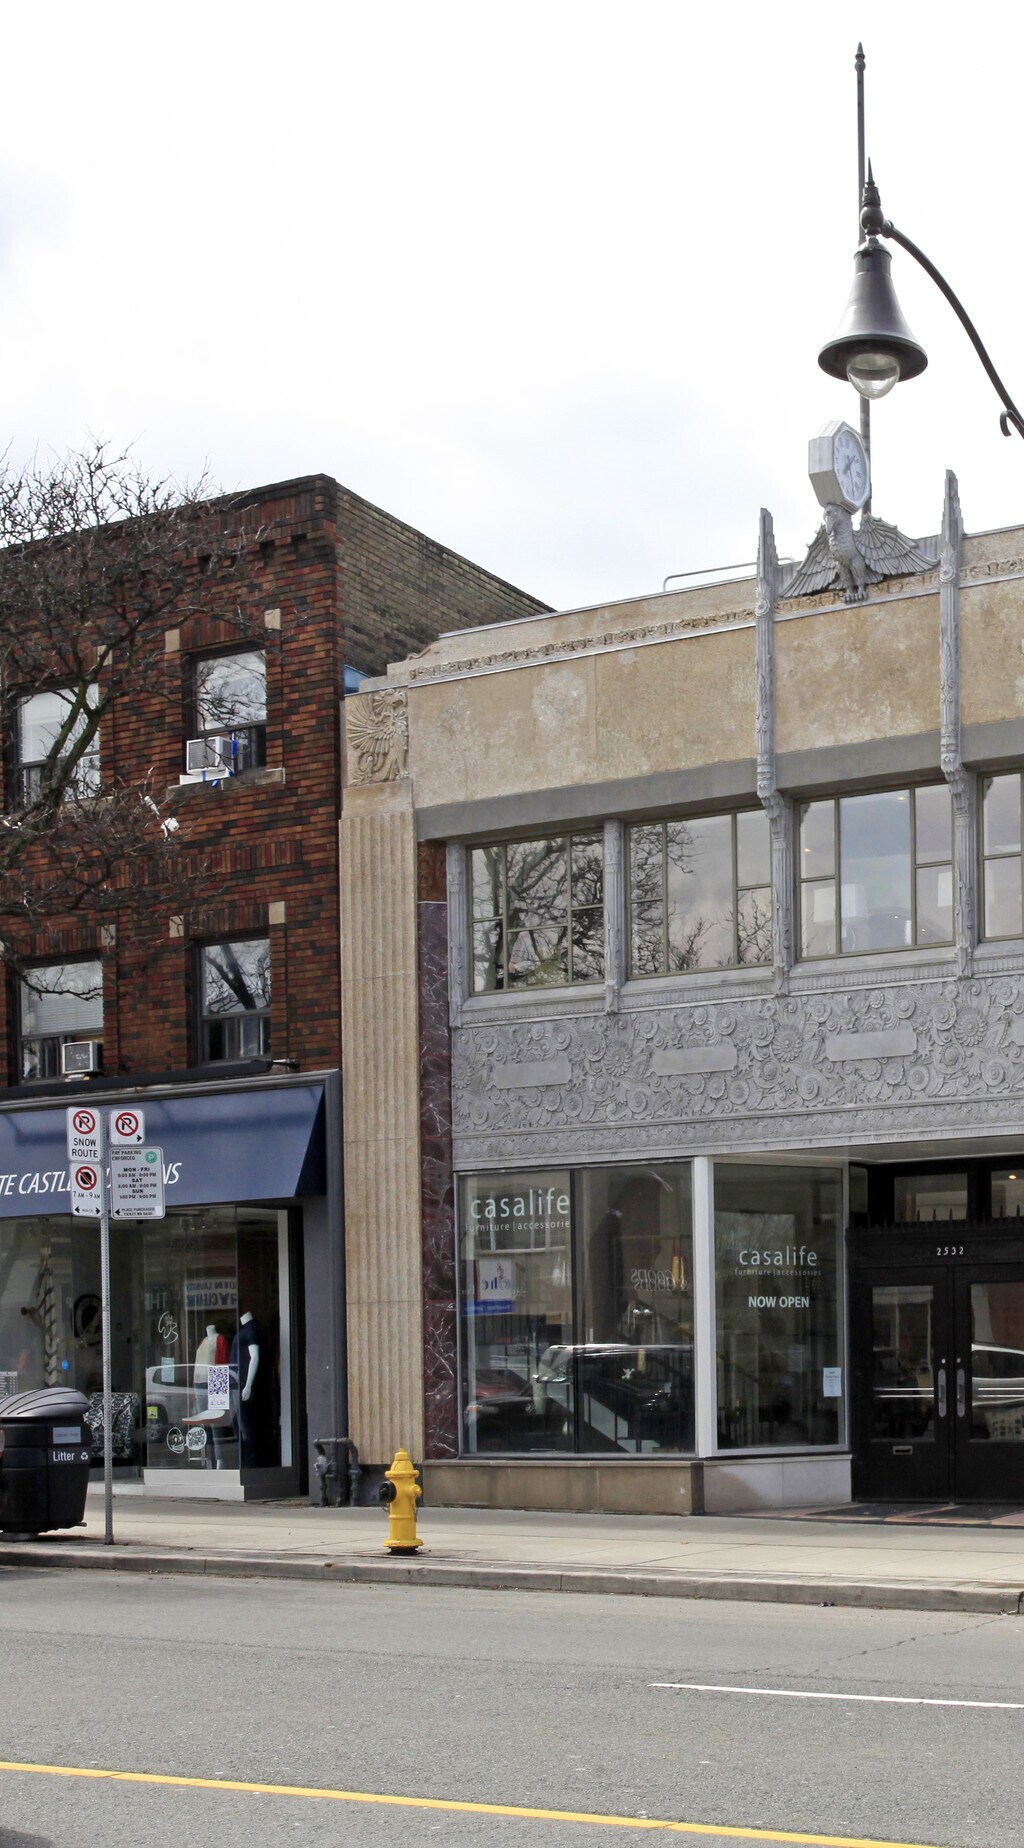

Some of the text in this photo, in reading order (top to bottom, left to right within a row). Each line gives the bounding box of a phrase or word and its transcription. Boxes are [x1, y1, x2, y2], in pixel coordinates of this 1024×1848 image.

[73, 1138, 97, 1147] SNOW
[72, 1149, 98, 1158] ROUTE
[470, 1187, 570, 1219] casalife
[466, 1219, 570, 1232] furniture accessorie
[739, 1246, 818, 1266] casalife
[936, 1246, 964, 1256] 2532
[735, 1267, 771, 1276] furniture
[748, 1296, 810, 1308] NOW OPEN
[53, 1451, 75, 1462] Litter
